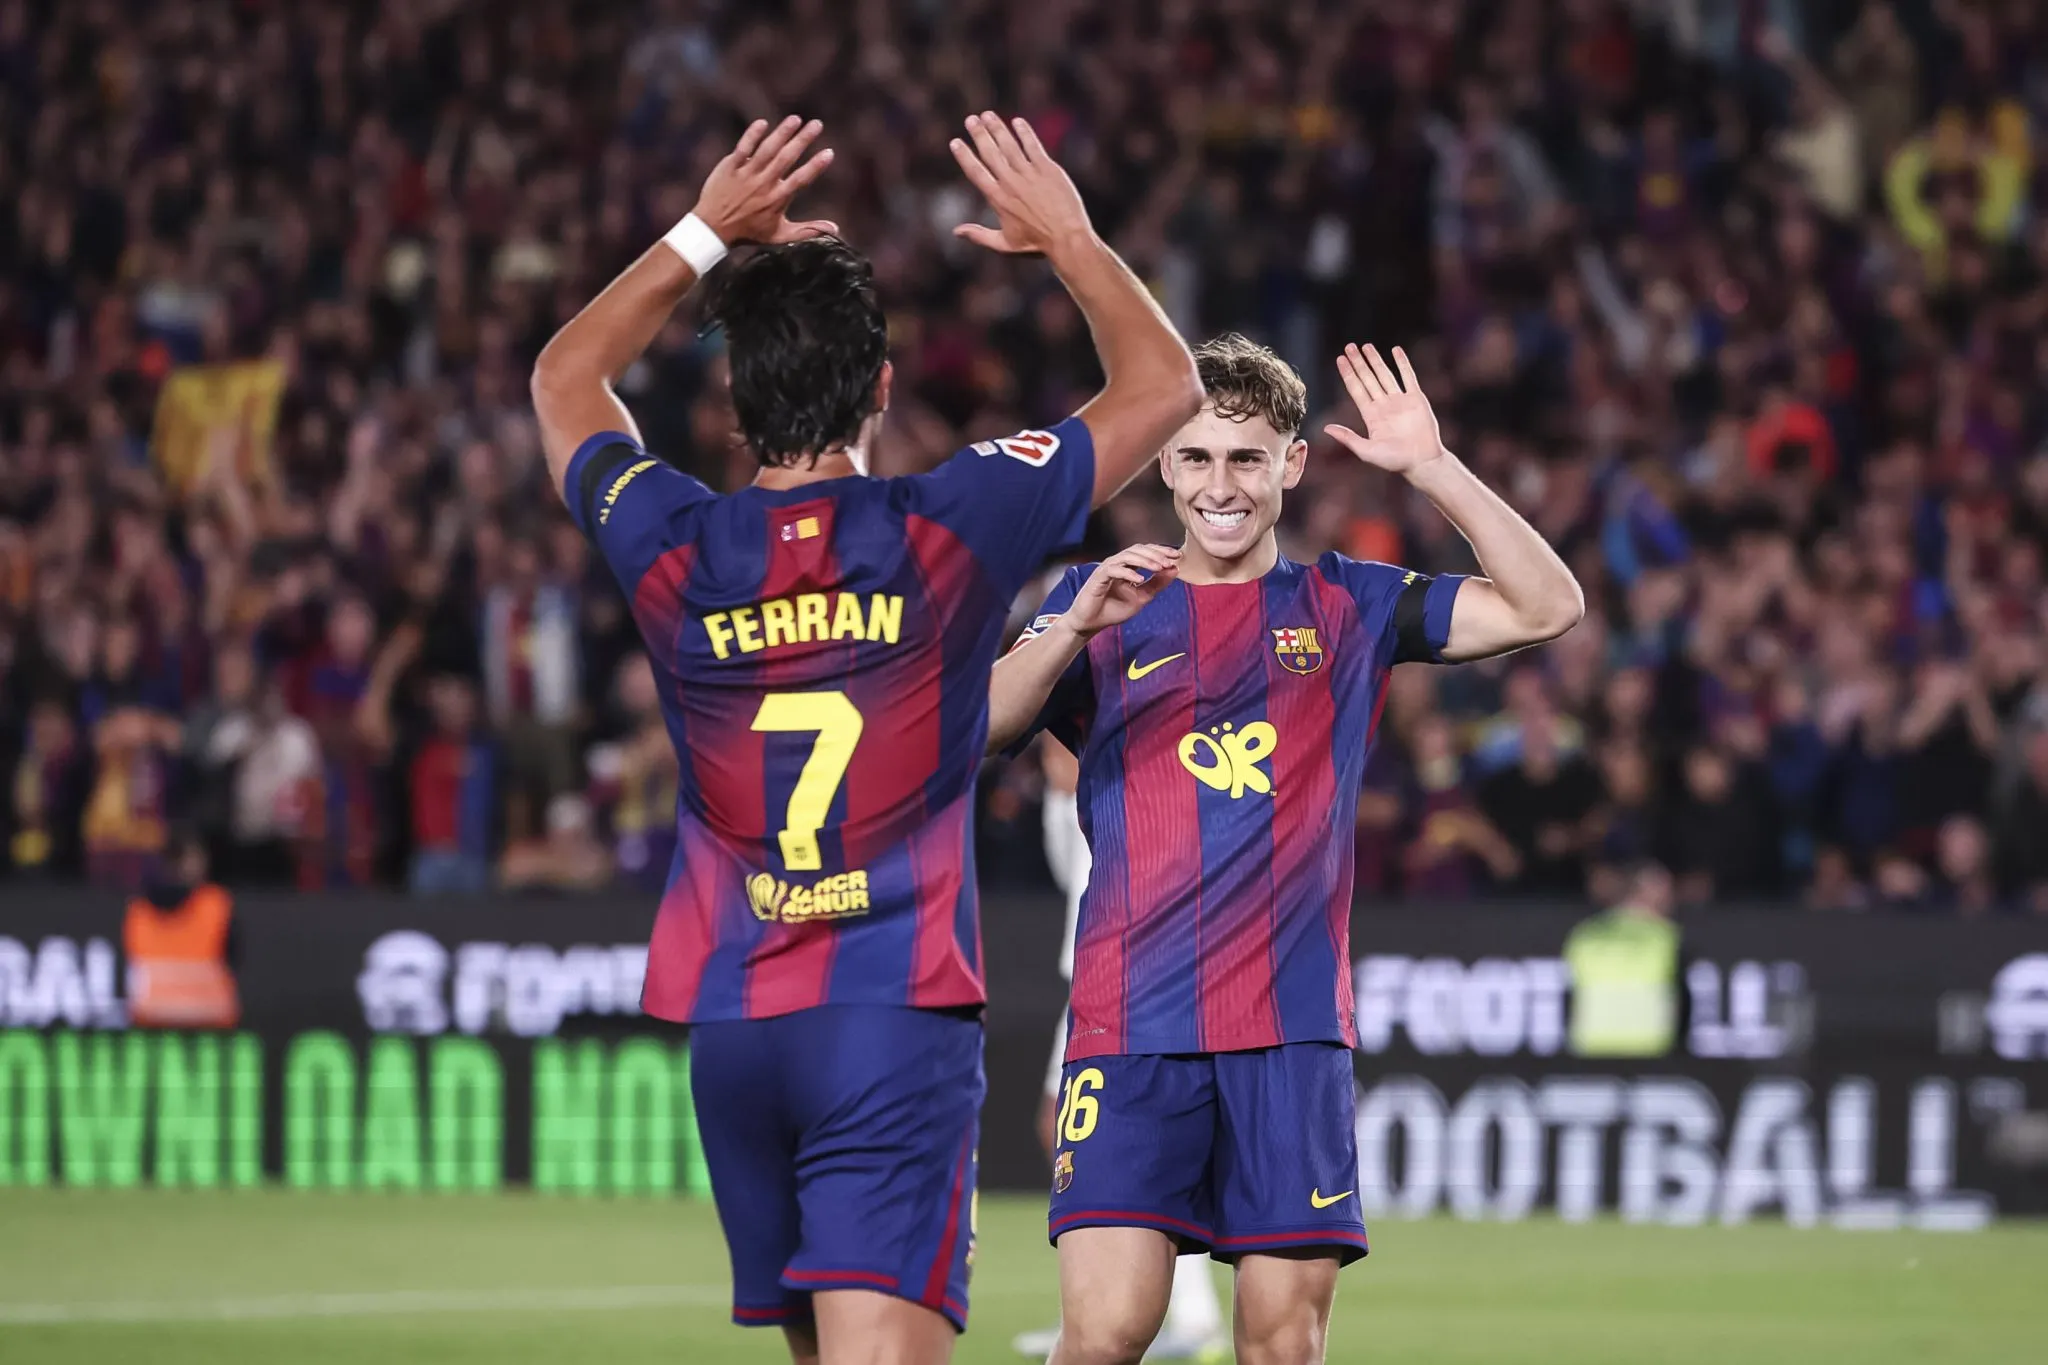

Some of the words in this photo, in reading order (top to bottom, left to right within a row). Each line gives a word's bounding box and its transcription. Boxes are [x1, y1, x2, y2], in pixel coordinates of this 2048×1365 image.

[703, 592, 904, 660] FERRAN
[750, 690, 864, 871] 7
[789, 869, 869, 904] UHCR
[1355, 953, 1786, 1059] FOOTLL
[532, 1033, 713, 1198] NO
[1056, 1067, 1105, 1149] 16
